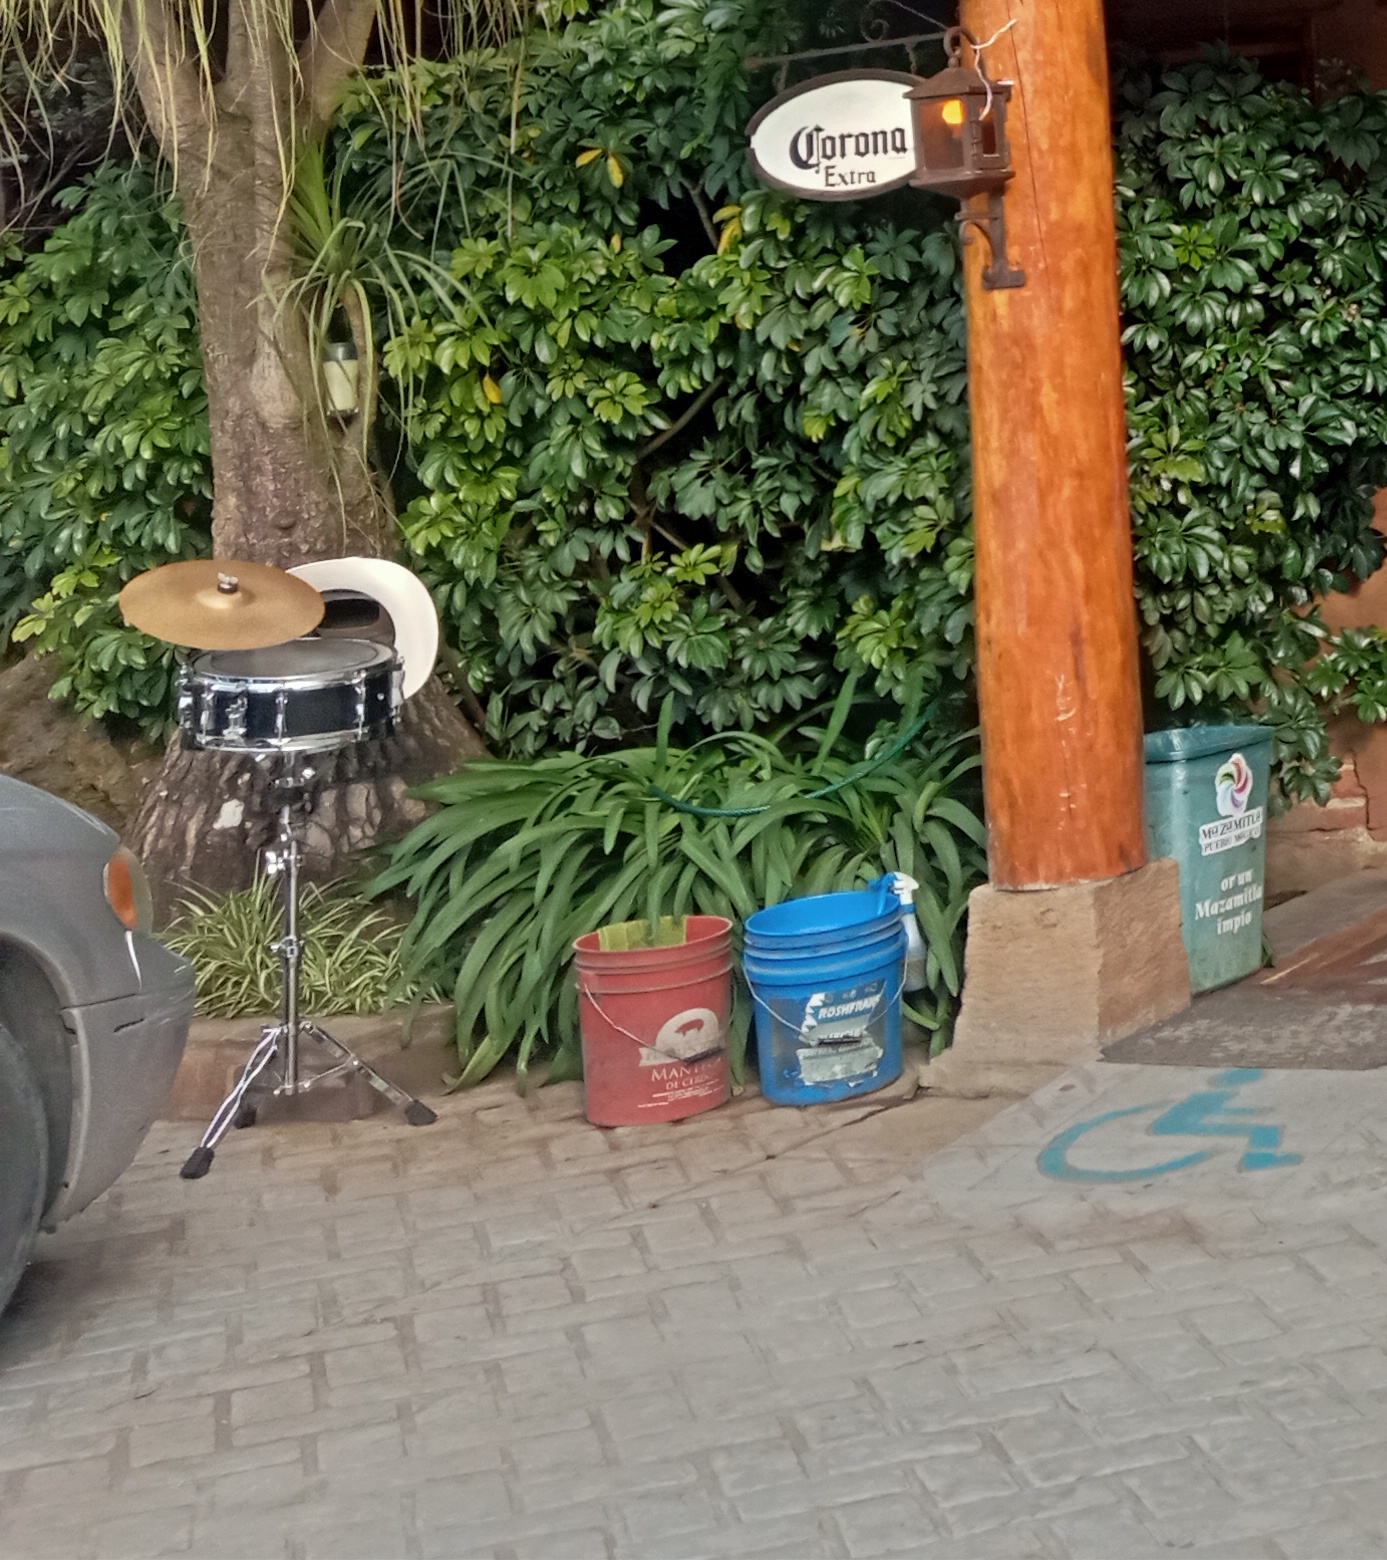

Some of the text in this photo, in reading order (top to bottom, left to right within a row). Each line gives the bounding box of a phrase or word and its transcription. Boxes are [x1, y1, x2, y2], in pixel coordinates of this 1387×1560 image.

[789, 124, 908, 174] Corona
[824, 165, 877, 187] Extra
[1194, 883, 1263, 921] Mazamitla
